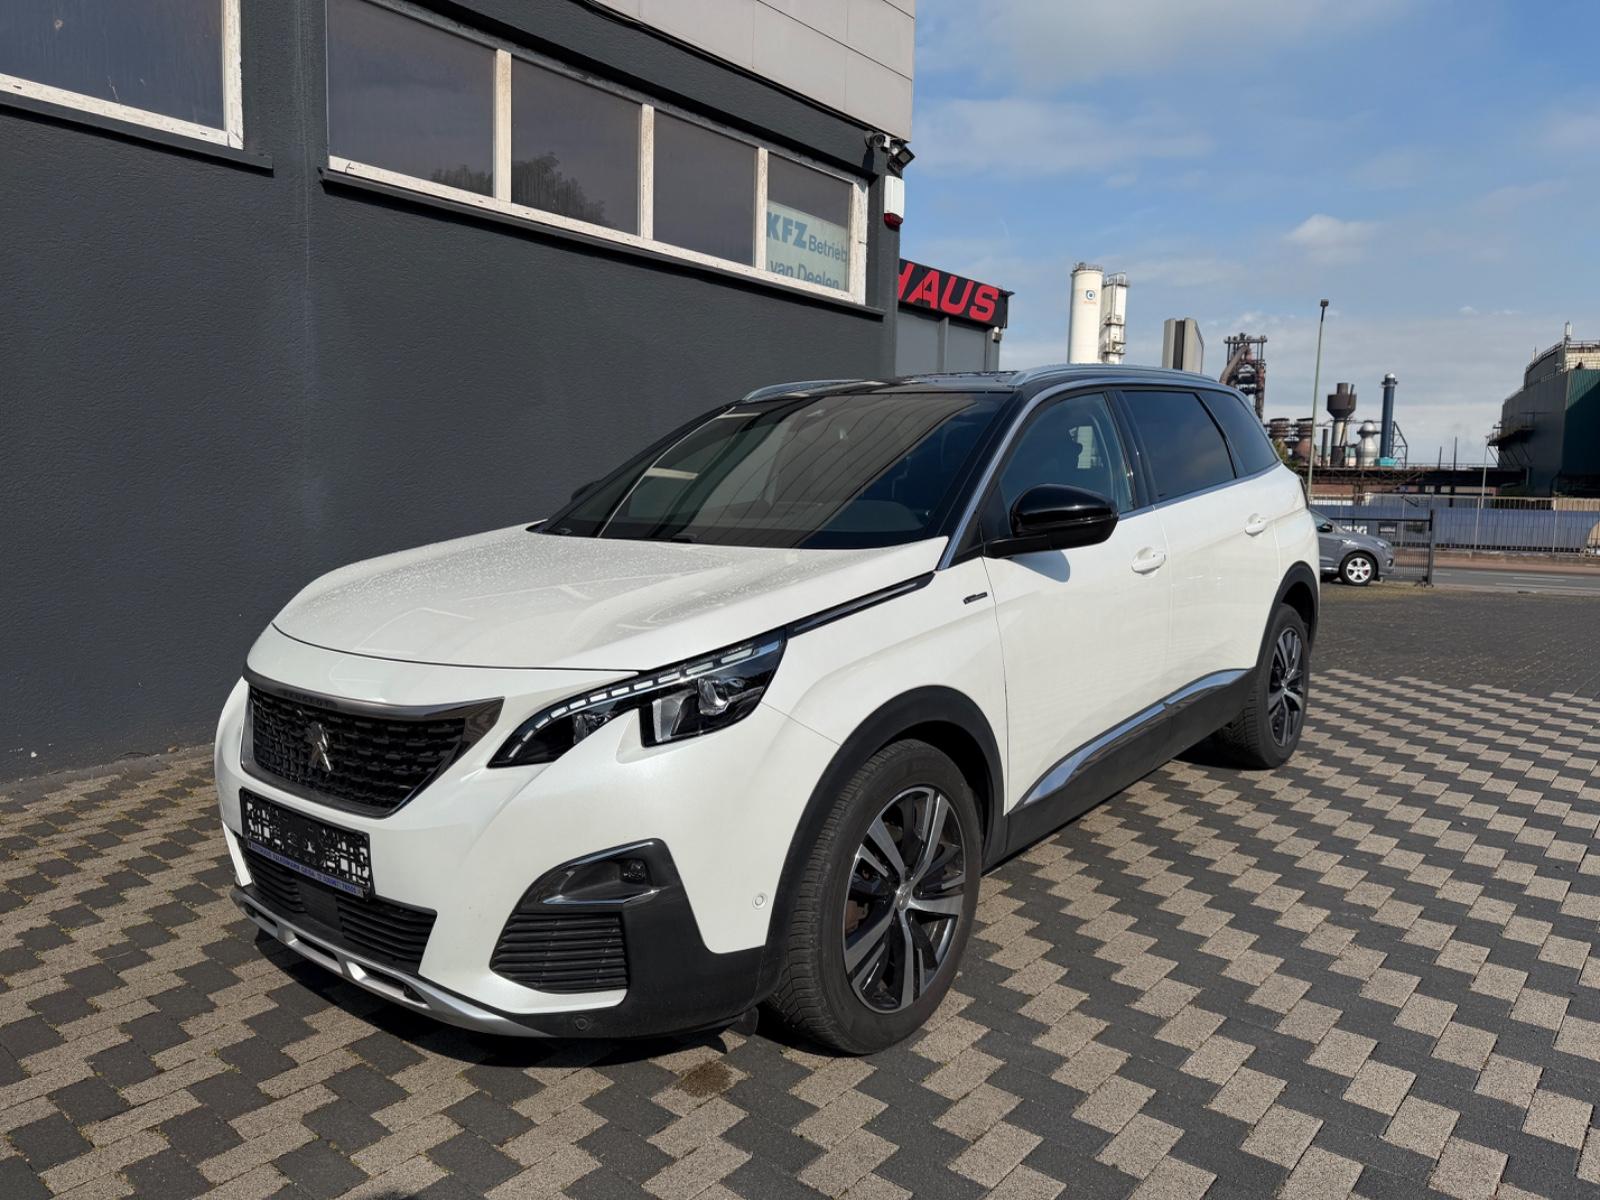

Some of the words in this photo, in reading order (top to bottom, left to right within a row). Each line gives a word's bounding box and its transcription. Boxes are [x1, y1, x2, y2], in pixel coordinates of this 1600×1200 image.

[767, 212, 808, 250] KFZ
[808, 234, 848, 263] Betrieb
[770, 260, 794, 278] van
